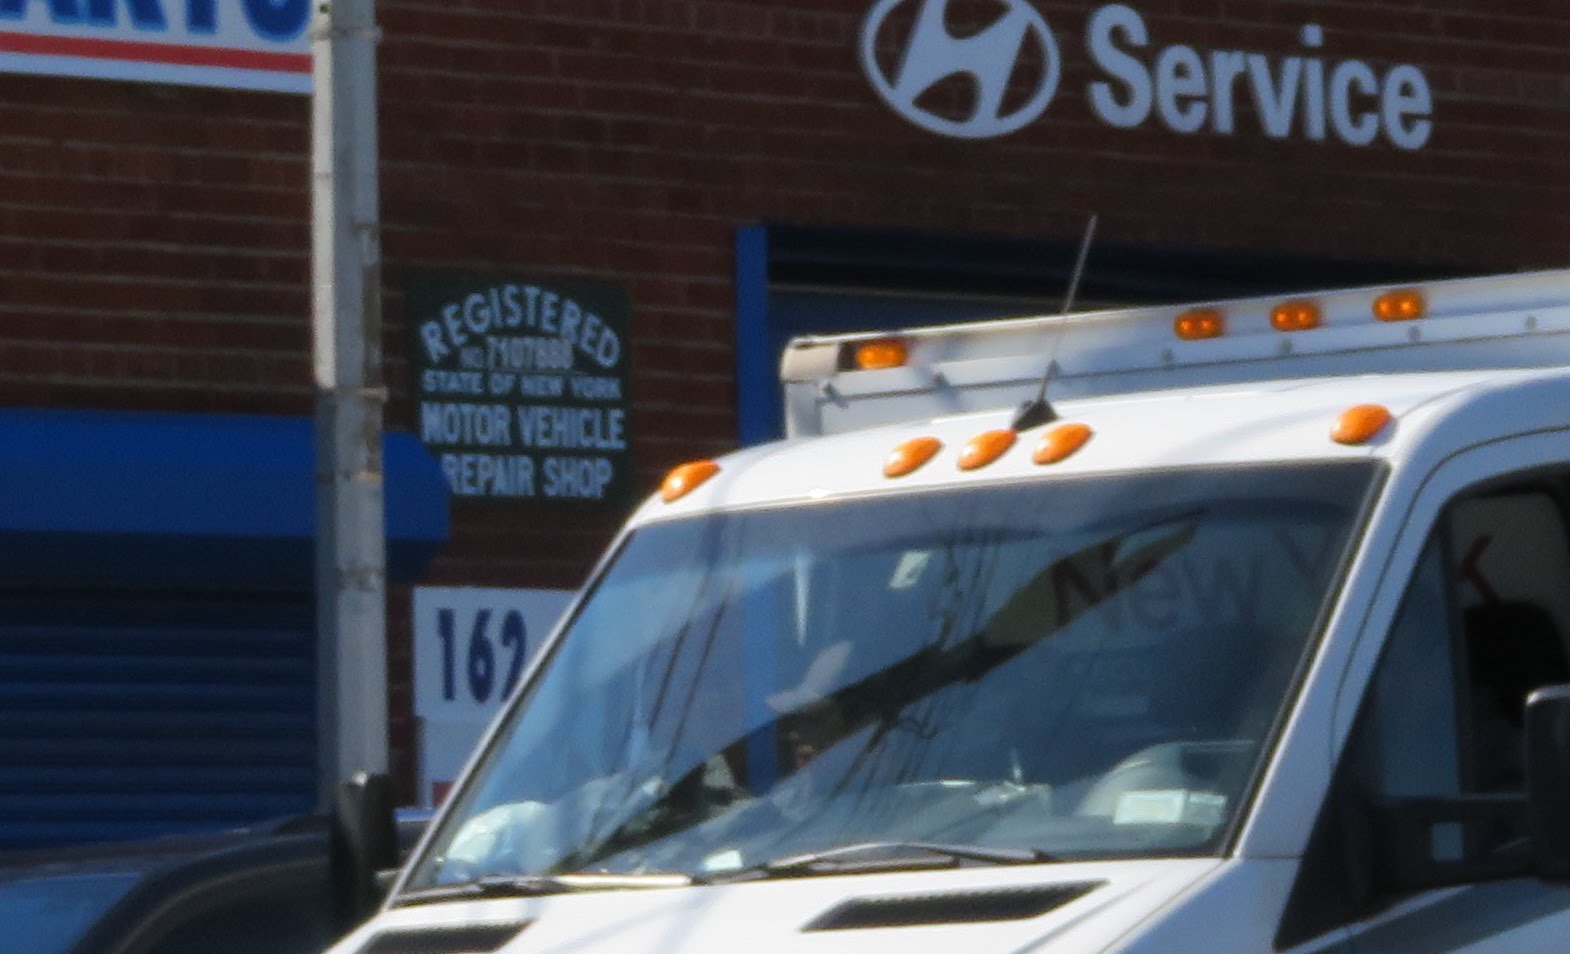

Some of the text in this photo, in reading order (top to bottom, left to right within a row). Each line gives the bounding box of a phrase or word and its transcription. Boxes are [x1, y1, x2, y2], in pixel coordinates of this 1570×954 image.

[1087, 2, 1433, 150] Service
[419, 283, 621, 369] REGISTERED
[421, 369, 623, 399] STATE OF NEW YORK
[420, 400, 628, 450] MOTOR VEHICLE
[440, 453, 614, 497] REPAIR SHOP
